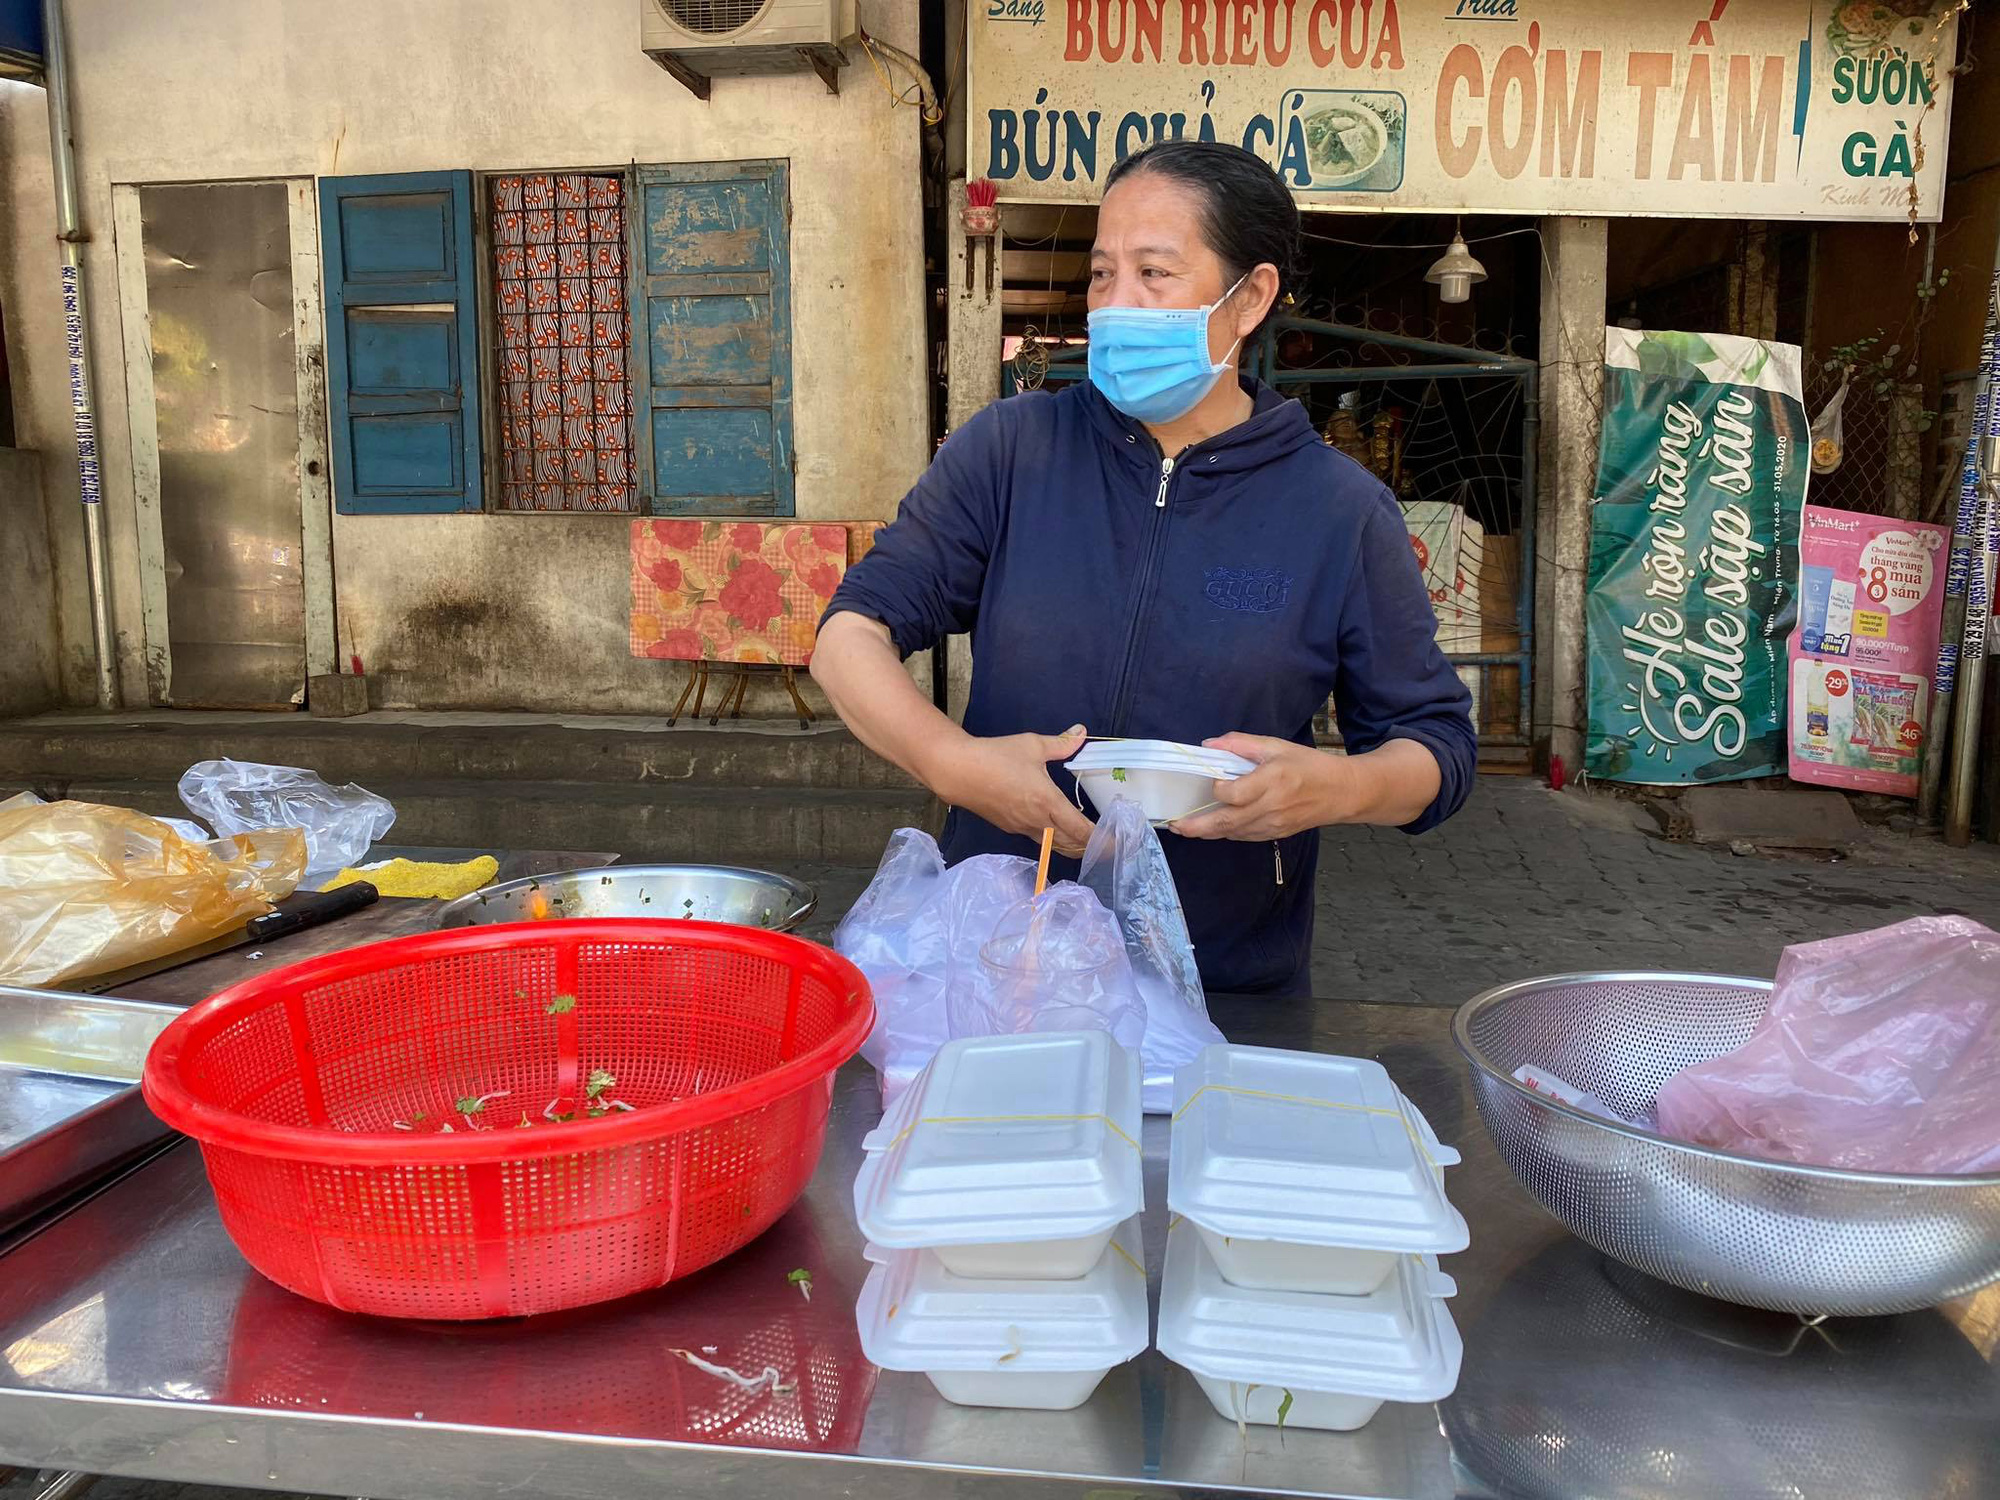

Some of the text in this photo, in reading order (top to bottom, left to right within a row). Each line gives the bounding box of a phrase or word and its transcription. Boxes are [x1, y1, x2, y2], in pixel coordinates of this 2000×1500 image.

[1308, 0, 1406, 70] CUA
[1434, 0, 1786, 184] CƠM TẤM
[986, 88, 1101, 183] BÚN
[1841, 120, 1915, 178] GÀ
[1621, 399, 1703, 699] Hè rộn ràng
[1673, 391, 1765, 758] Sale sập sàn
[1763, 613, 1775, 637] Nam
[1773, 435, 1787, 492] 31.05.2020
[1890, 571, 1922, 585] mua
